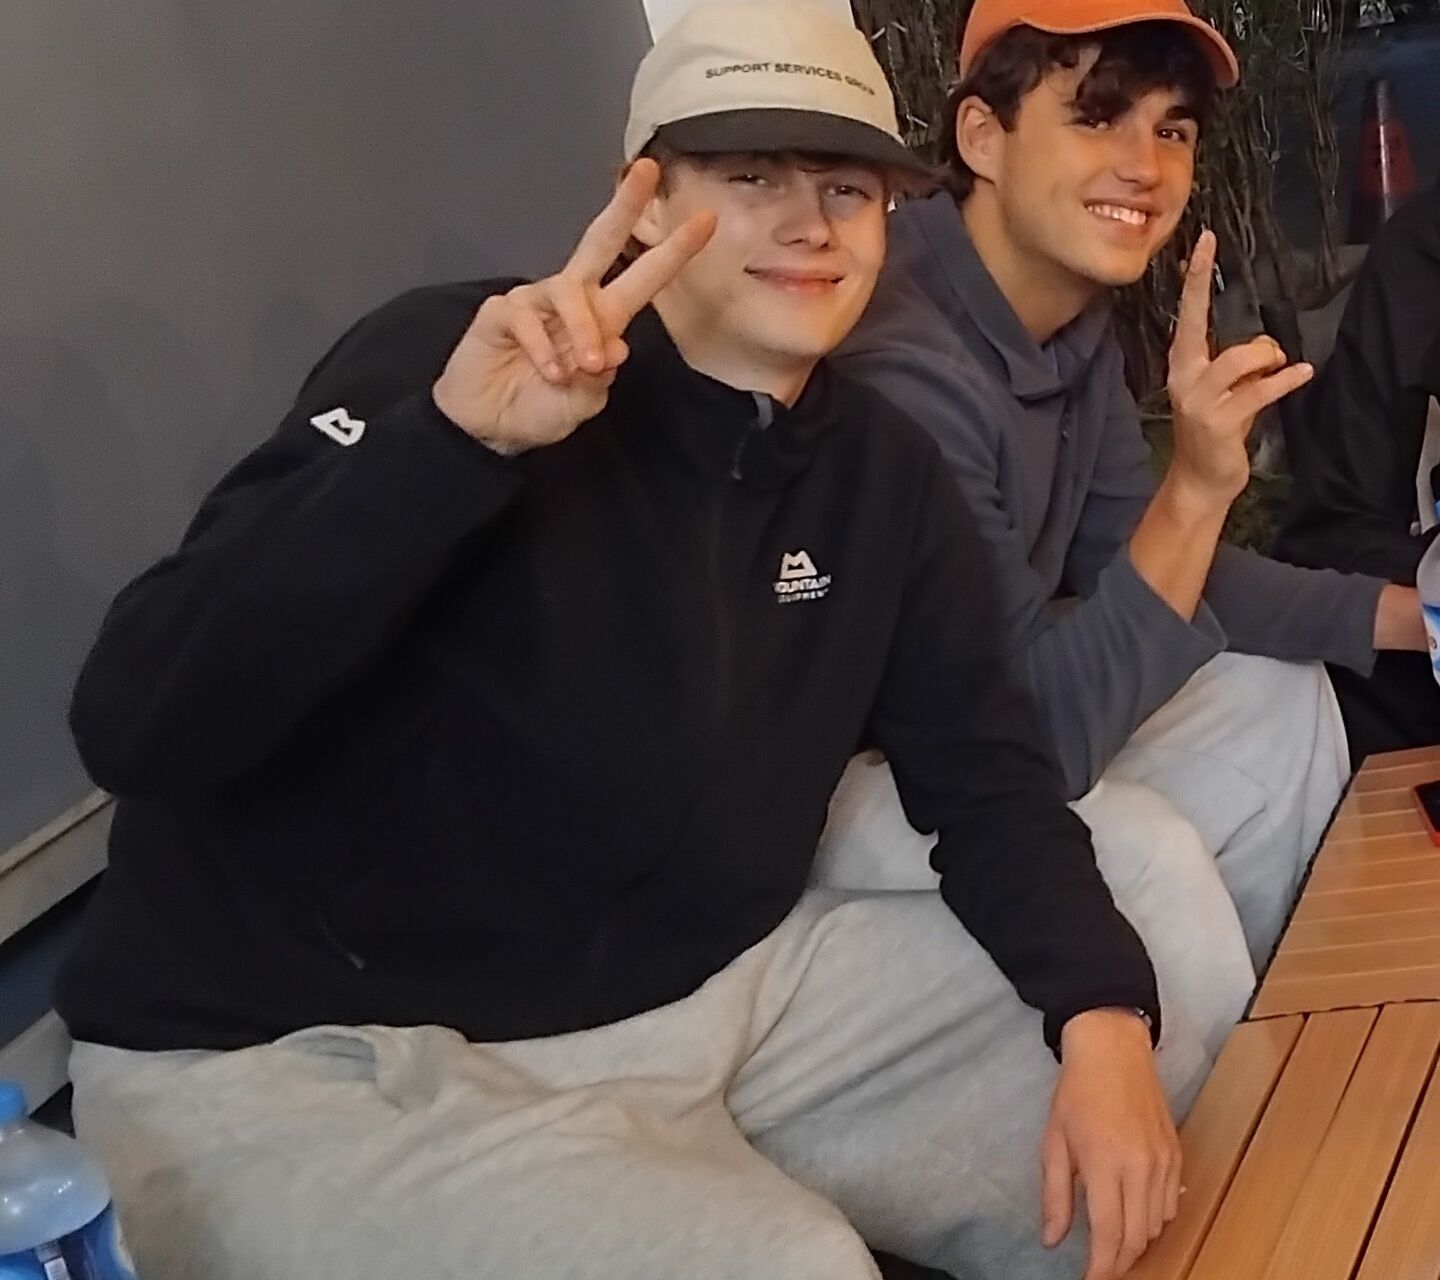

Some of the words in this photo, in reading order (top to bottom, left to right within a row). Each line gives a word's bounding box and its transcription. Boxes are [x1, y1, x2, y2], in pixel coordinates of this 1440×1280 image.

[705, 62, 771, 79] SUPPORT
[774, 62, 842, 81] SERVICES
[772, 574, 832, 594] OUNTAIN
